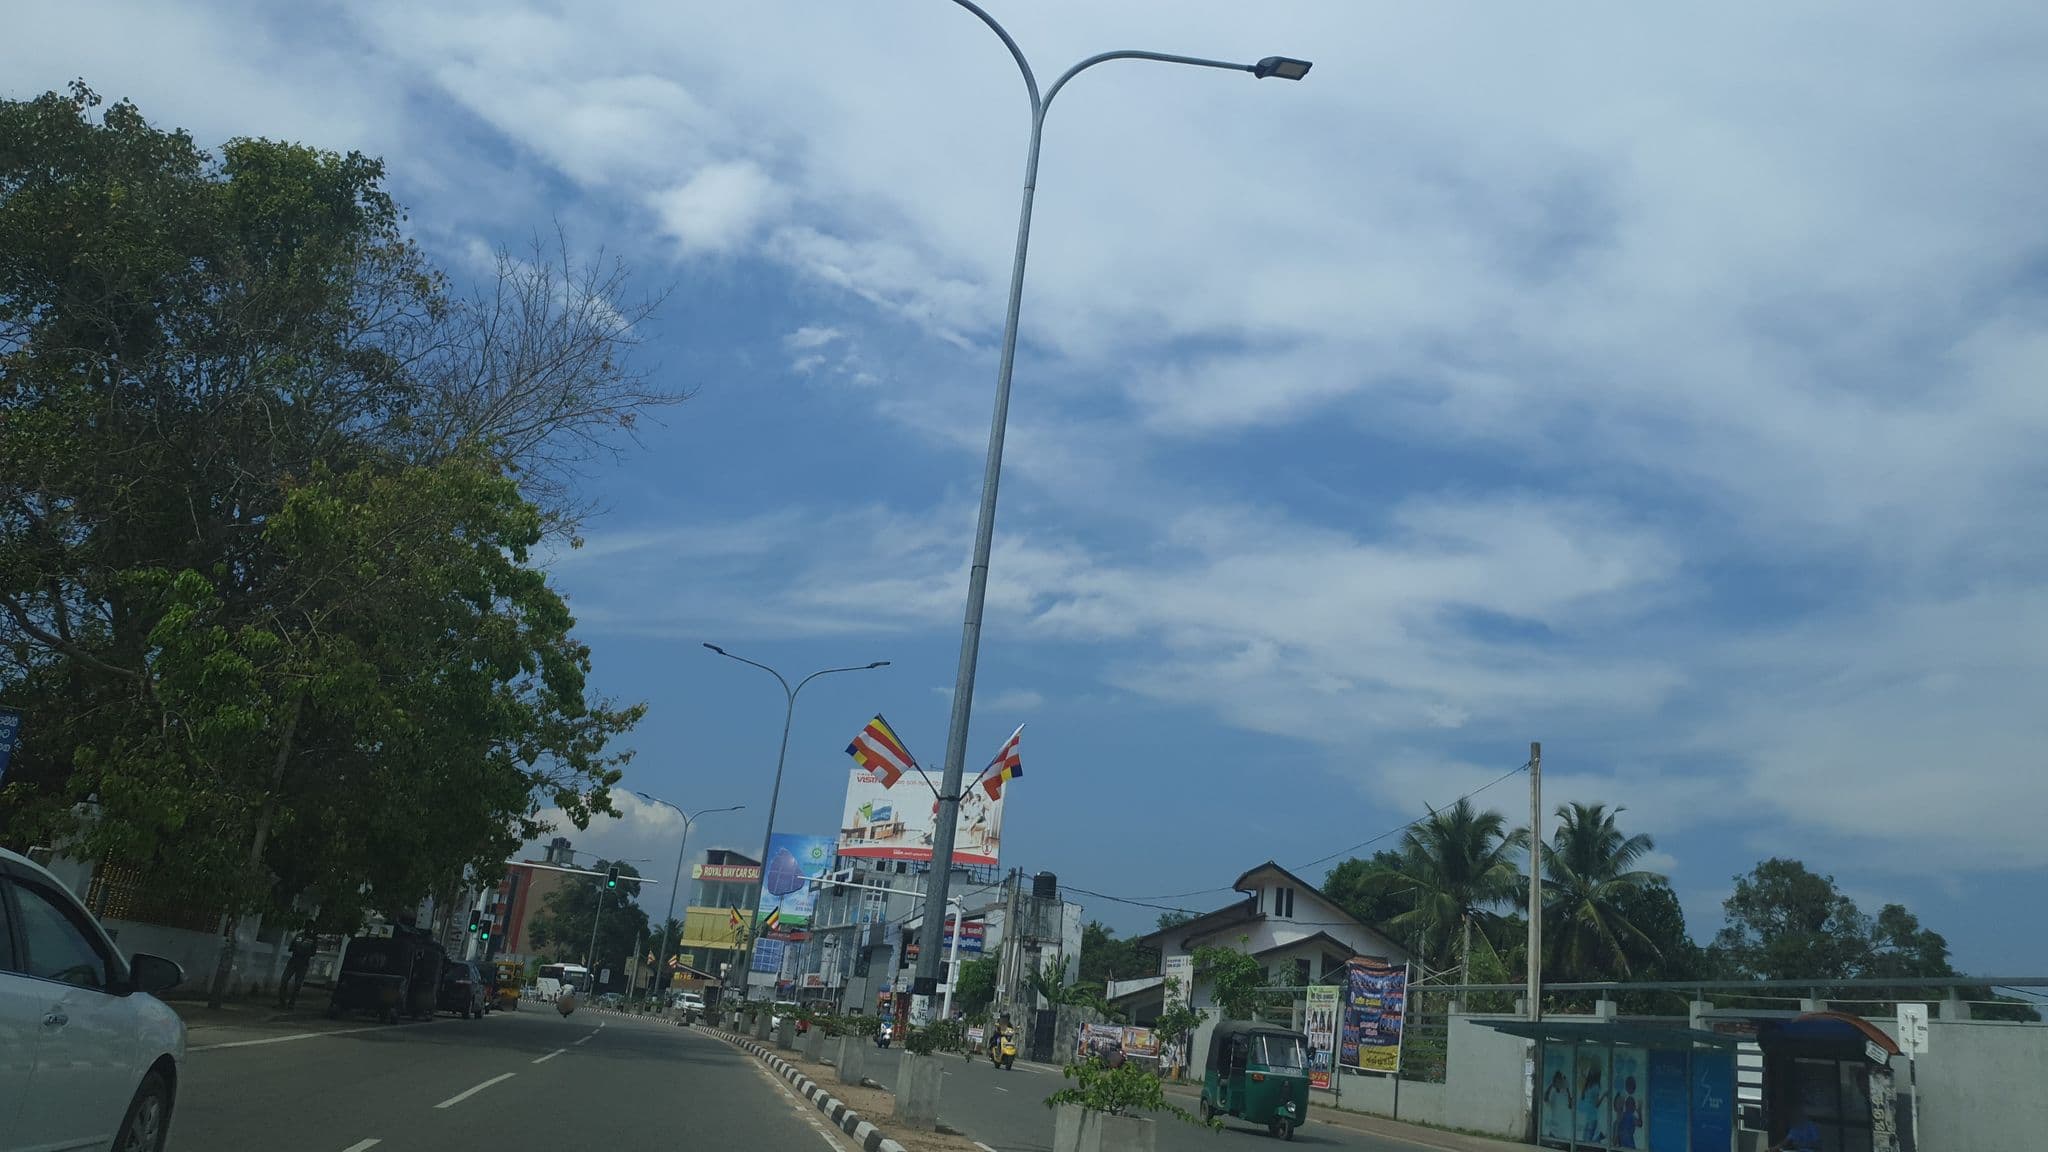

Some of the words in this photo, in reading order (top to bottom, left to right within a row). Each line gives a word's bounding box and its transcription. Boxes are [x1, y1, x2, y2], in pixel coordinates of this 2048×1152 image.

[704, 866, 721, 877] ROYAL
[736, 868, 747, 878] CAR
[747, 868, 761, 878] SAL
